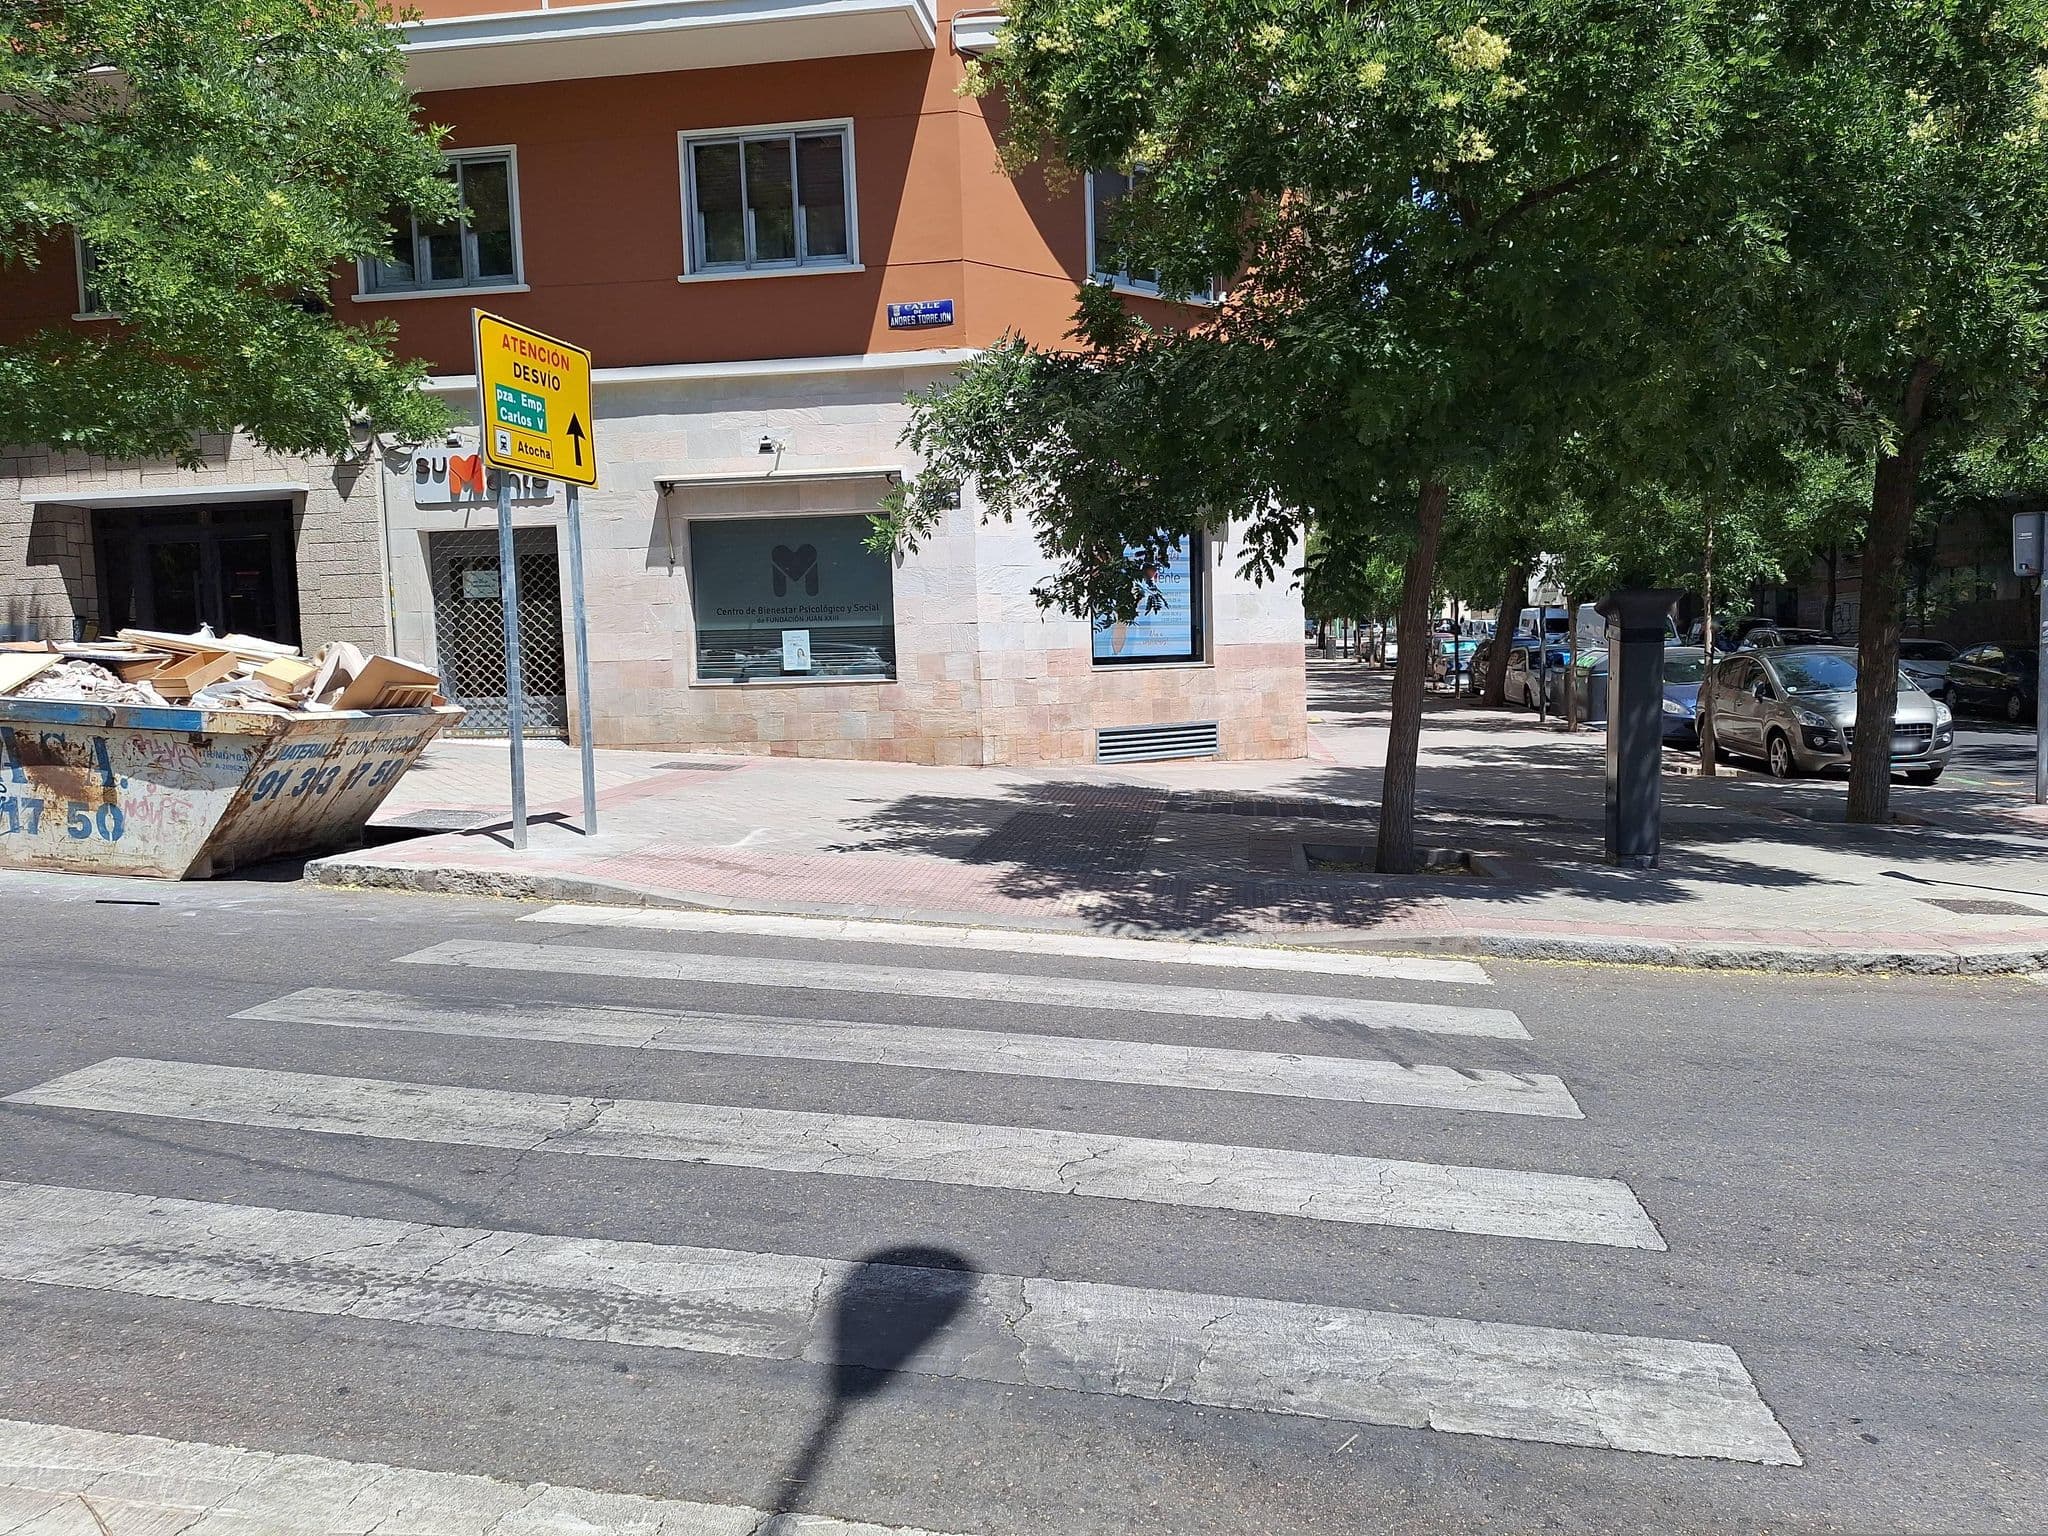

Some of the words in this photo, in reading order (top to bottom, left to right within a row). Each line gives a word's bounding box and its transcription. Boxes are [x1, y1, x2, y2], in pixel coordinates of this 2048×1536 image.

[904, 302, 940, 310] CALLE
[502, 333, 570, 371] ATENCIÓN
[496, 388, 517, 404] pza.
[521, 394, 545, 413] Emp.
[500, 408, 532, 427] Carlos
[537, 417, 545, 430] V
[517, 440, 551, 460] Atocha
[716, 607, 745, 616] Centro
[746, 607, 756, 615] de
[757, 606, 798, 616] Bienestar
[798, 604, 846, 616] Psicológico
[846, 605, 853, 615] y
[853, 603, 880, 612] Social
[765, 615, 805, 623] FUNDACIÓN
[252, 768, 294, 801] 91
[368, 758, 405, 787] 50
[67, 800, 125, 842] 50
